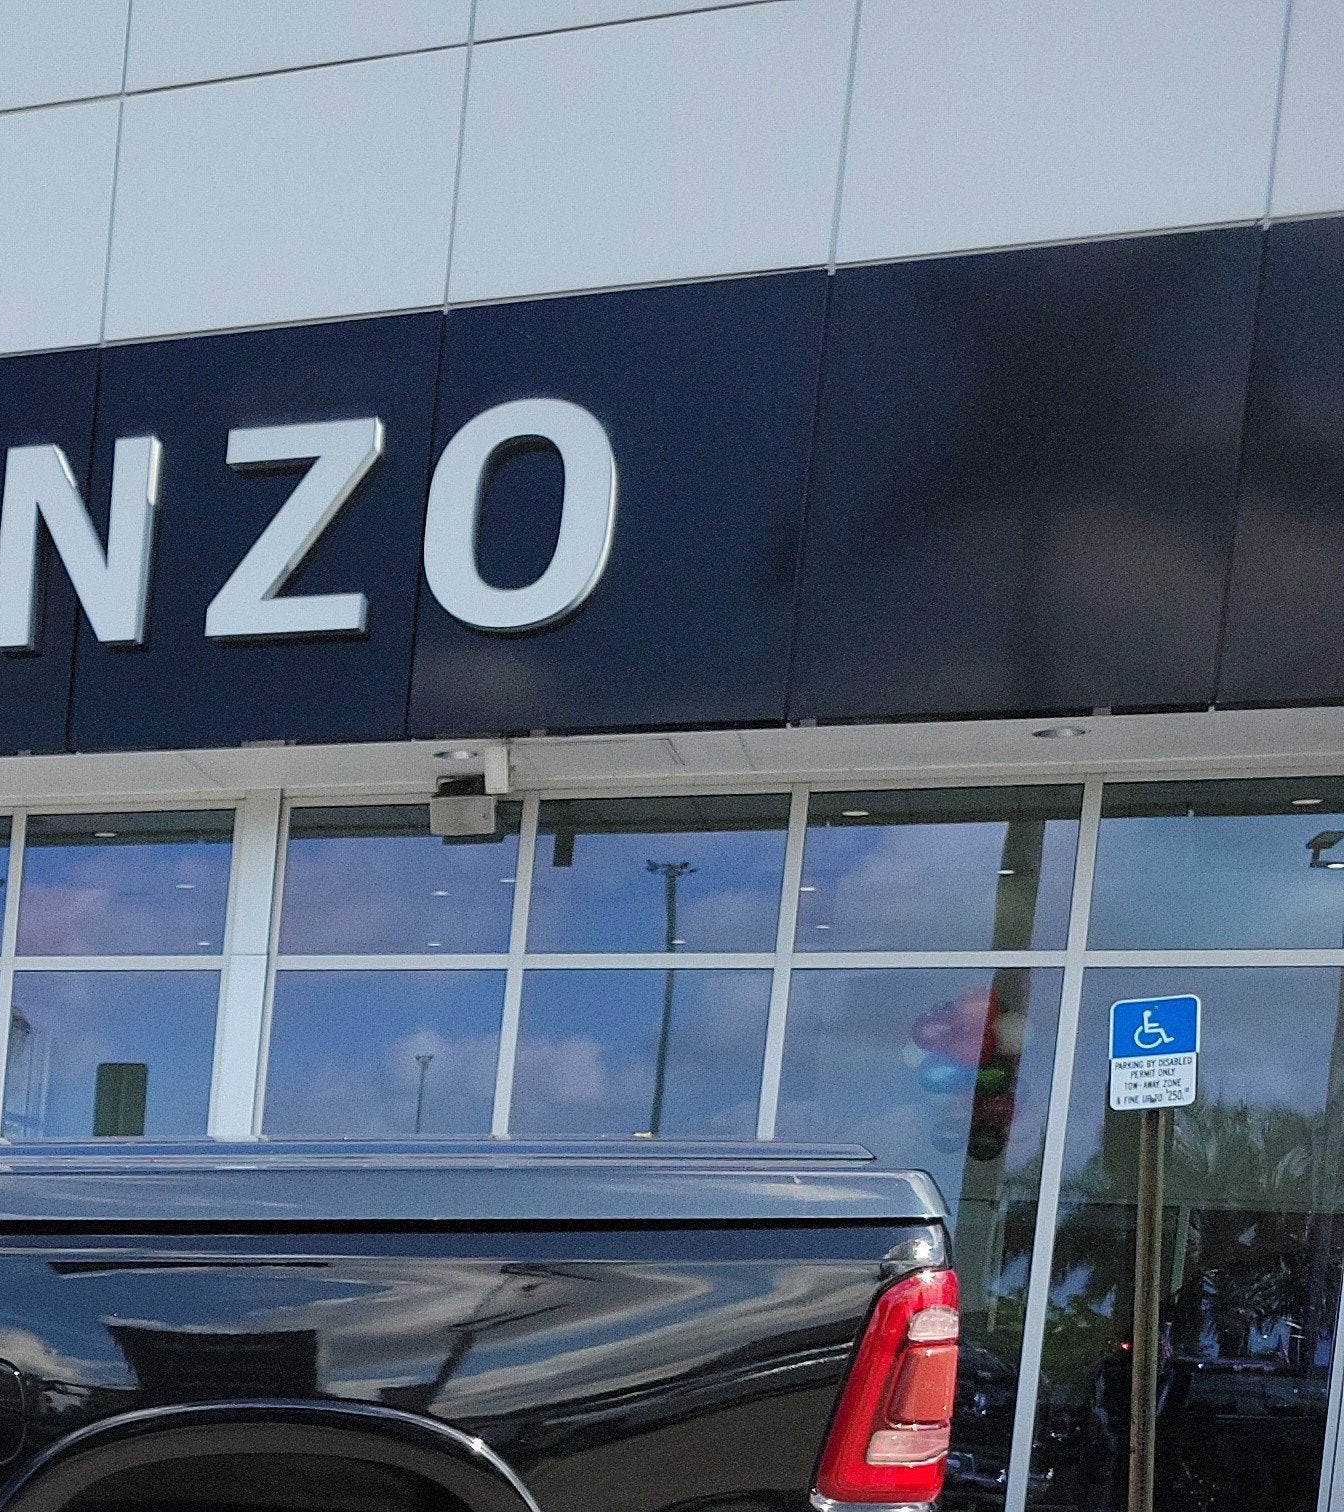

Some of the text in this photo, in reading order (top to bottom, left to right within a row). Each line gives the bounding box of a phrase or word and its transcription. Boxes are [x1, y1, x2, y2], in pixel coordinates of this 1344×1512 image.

[1115, 1056, 1193, 1070] PARKING BY DISABLED
[1130, 1067, 1176, 1079] PERMIT ONLY
[1163, 1078, 1182, 1088] ZONE
